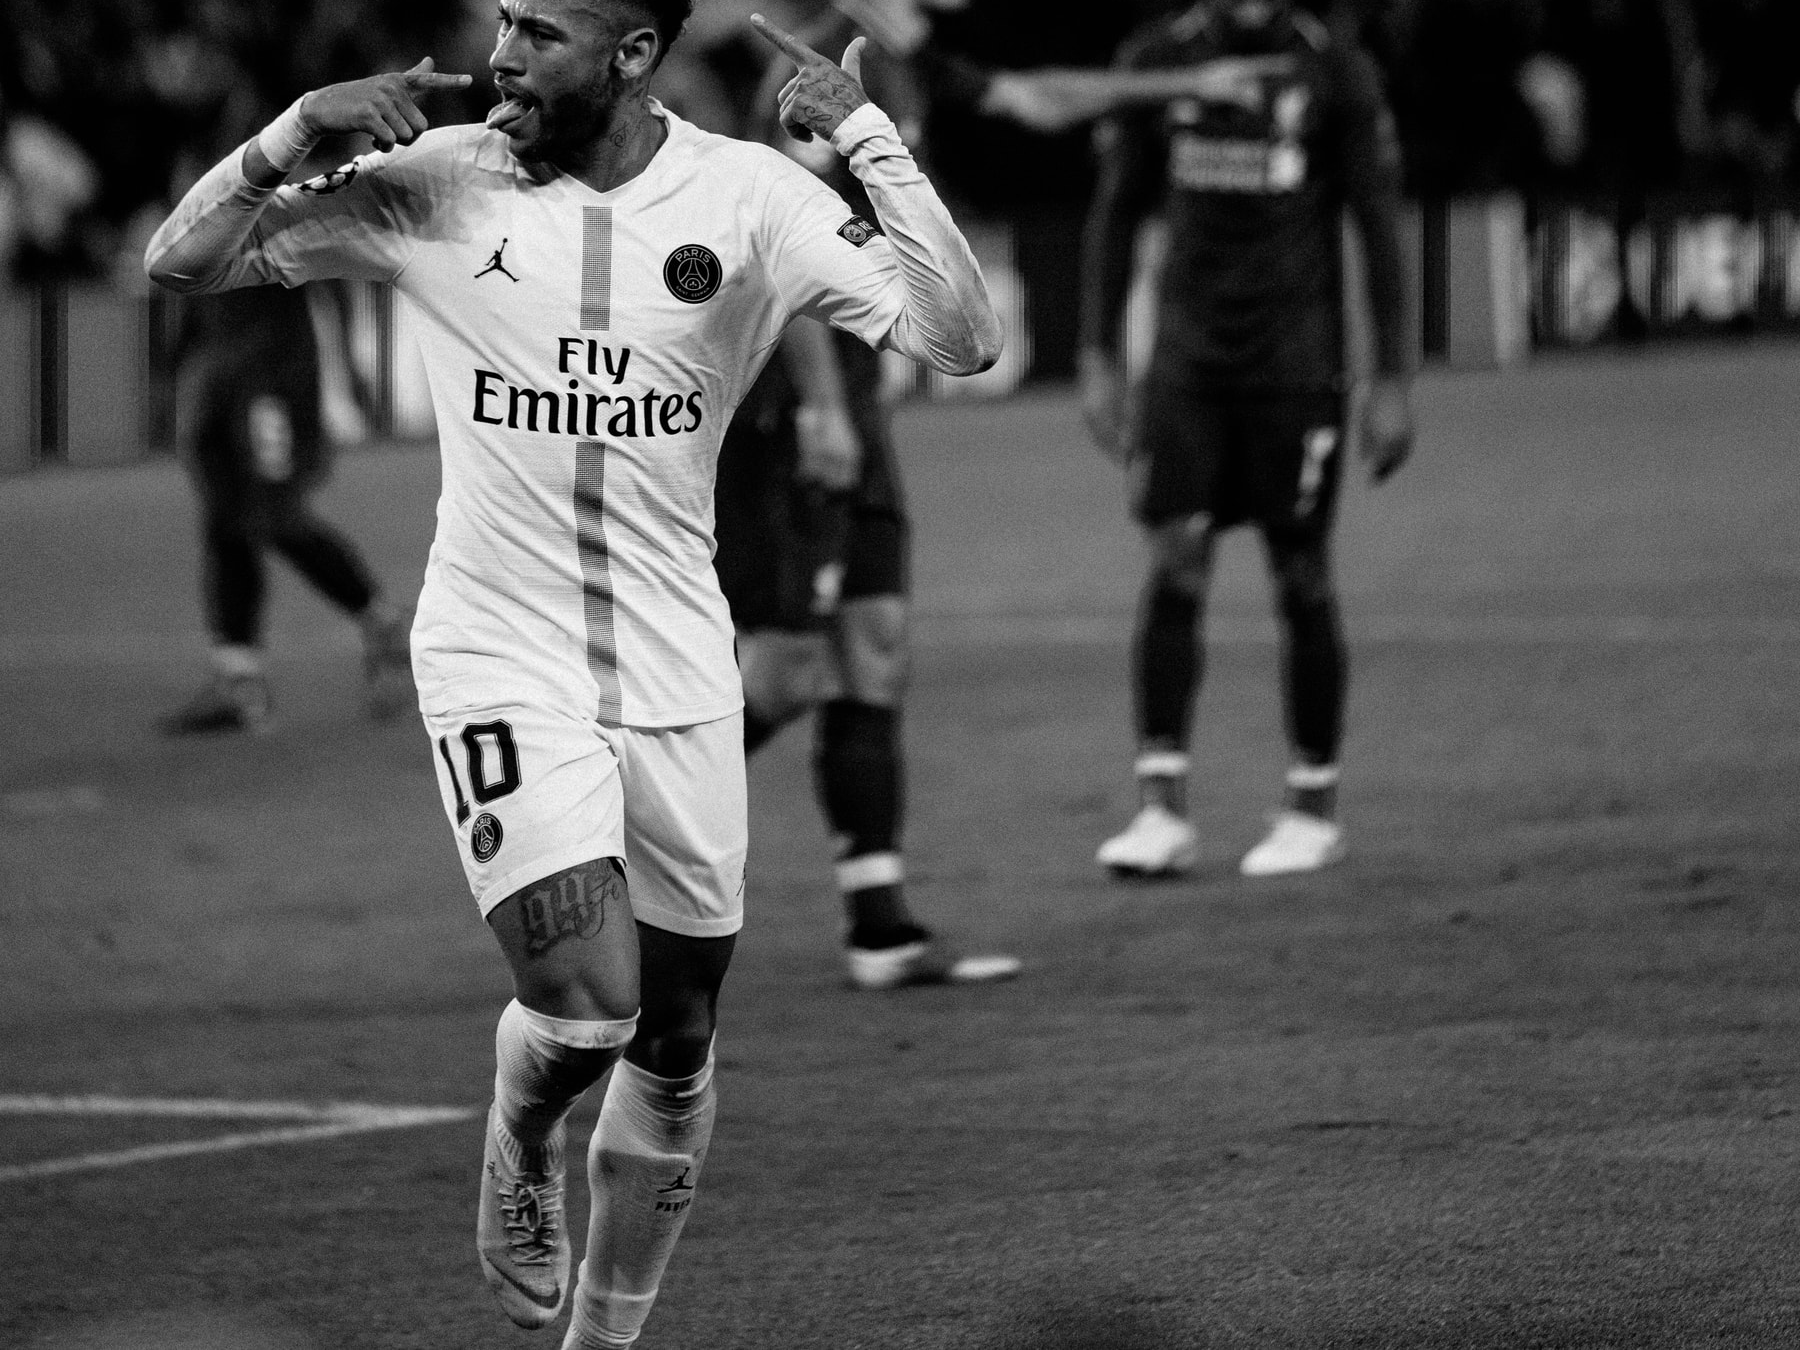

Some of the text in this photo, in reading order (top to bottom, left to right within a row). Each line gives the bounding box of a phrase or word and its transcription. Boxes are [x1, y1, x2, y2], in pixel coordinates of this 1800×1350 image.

[675, 249, 711, 263] PARIS
[558, 337, 631, 385] Fly
[473, 368, 703, 438] Emirates
[439, 718, 522, 828] 10
